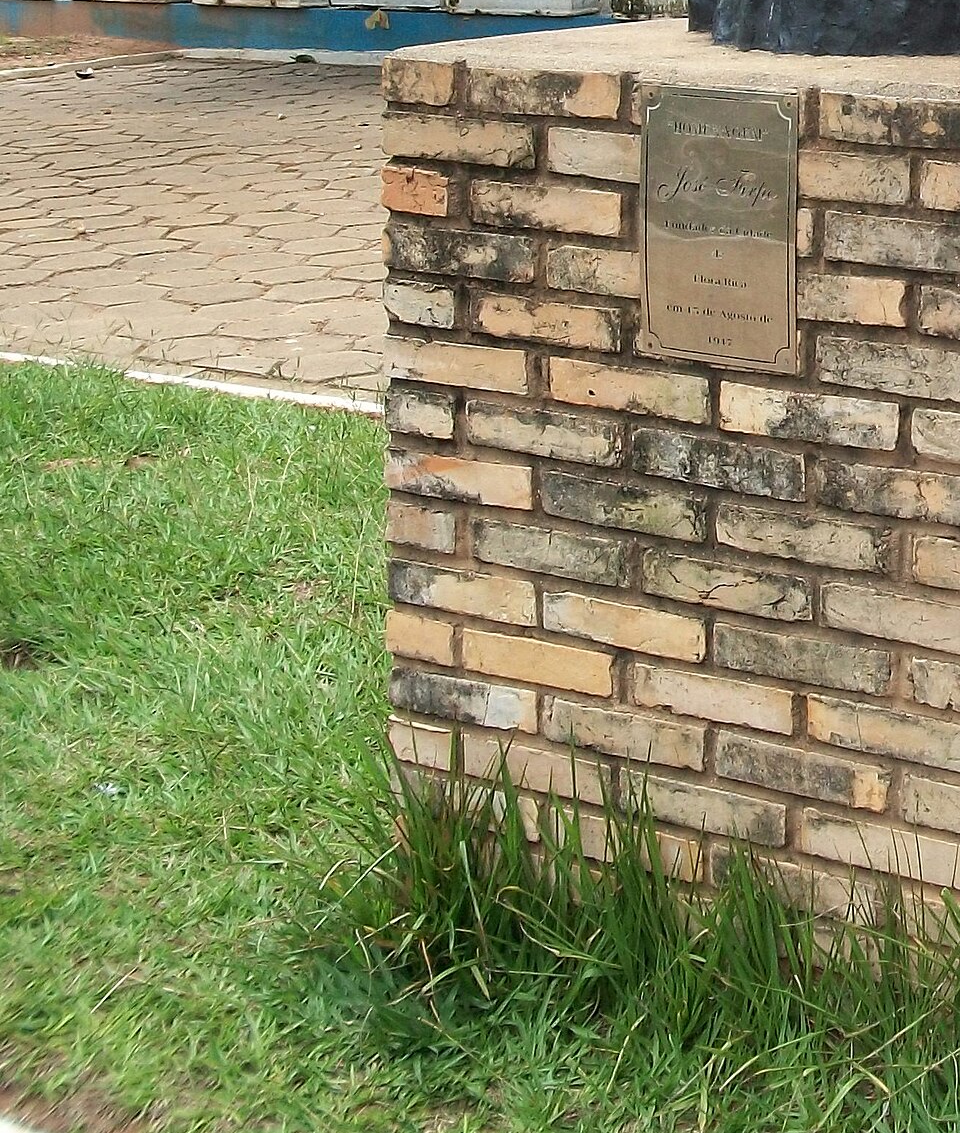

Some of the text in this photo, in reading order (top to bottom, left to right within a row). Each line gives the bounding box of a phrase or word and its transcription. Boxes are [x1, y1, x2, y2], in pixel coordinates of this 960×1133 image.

[657, 167, 709, 203] José
[692, 273, 747, 289] Flora Rica
[666, 304, 683, 314] em
[702, 307, 716, 317] de
[719, 310, 757, 322] Agosto
[759, 314, 773, 324] de
